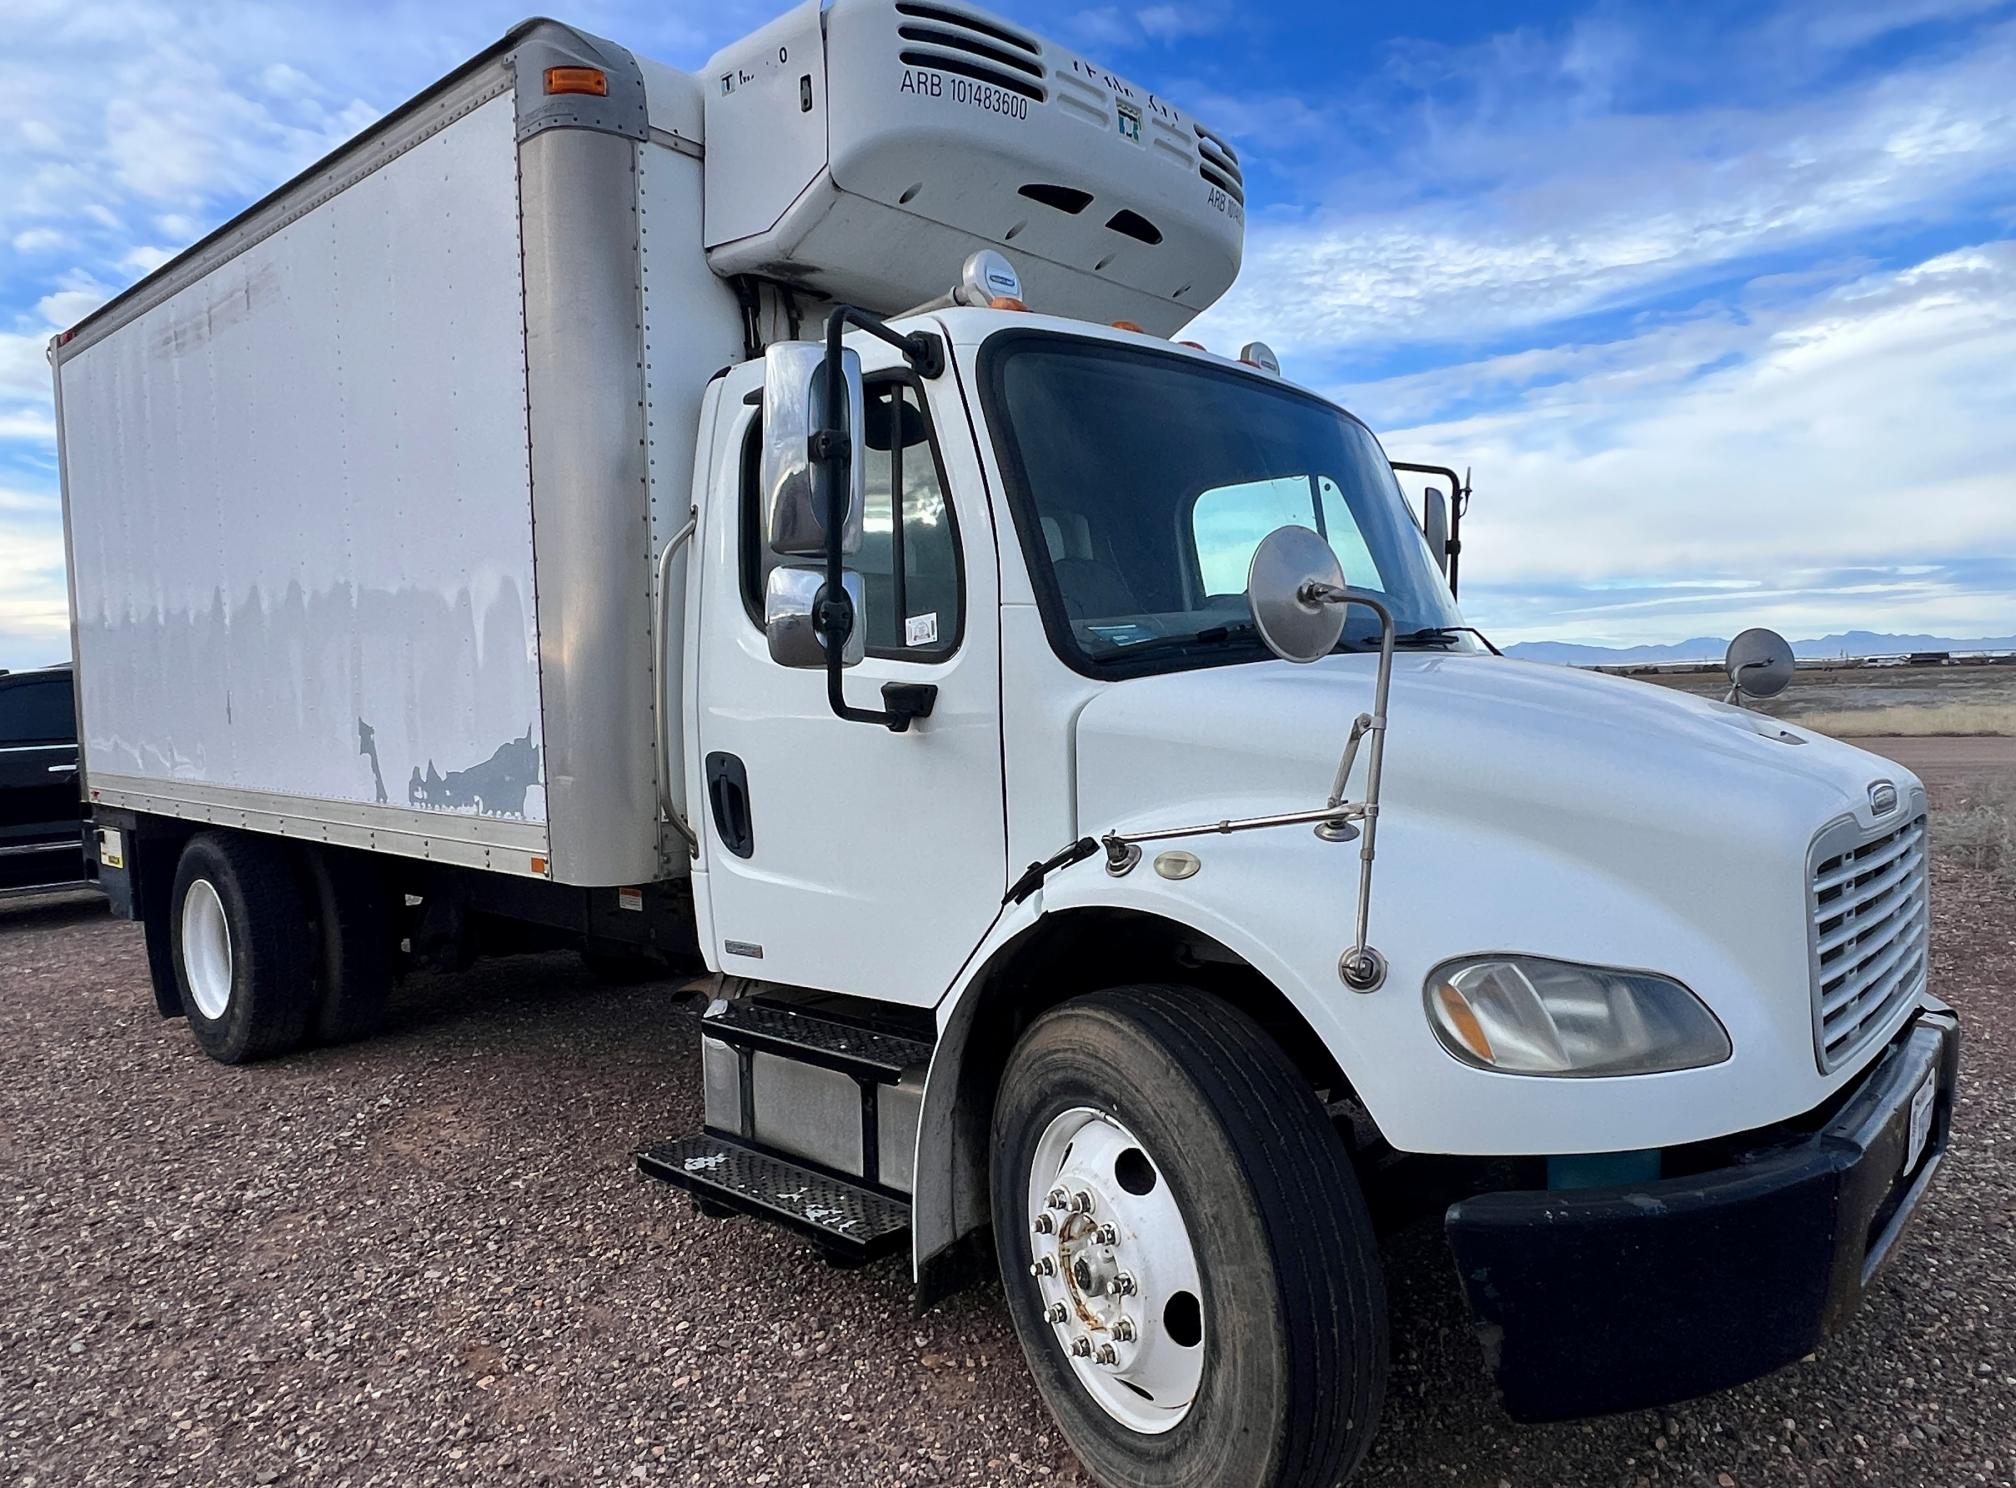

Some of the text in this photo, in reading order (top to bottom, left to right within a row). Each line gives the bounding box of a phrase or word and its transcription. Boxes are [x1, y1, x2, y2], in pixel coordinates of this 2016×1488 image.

[900, 70, 1028, 120] ARB 101483600
[1207, 187, 1227, 212] ARB
